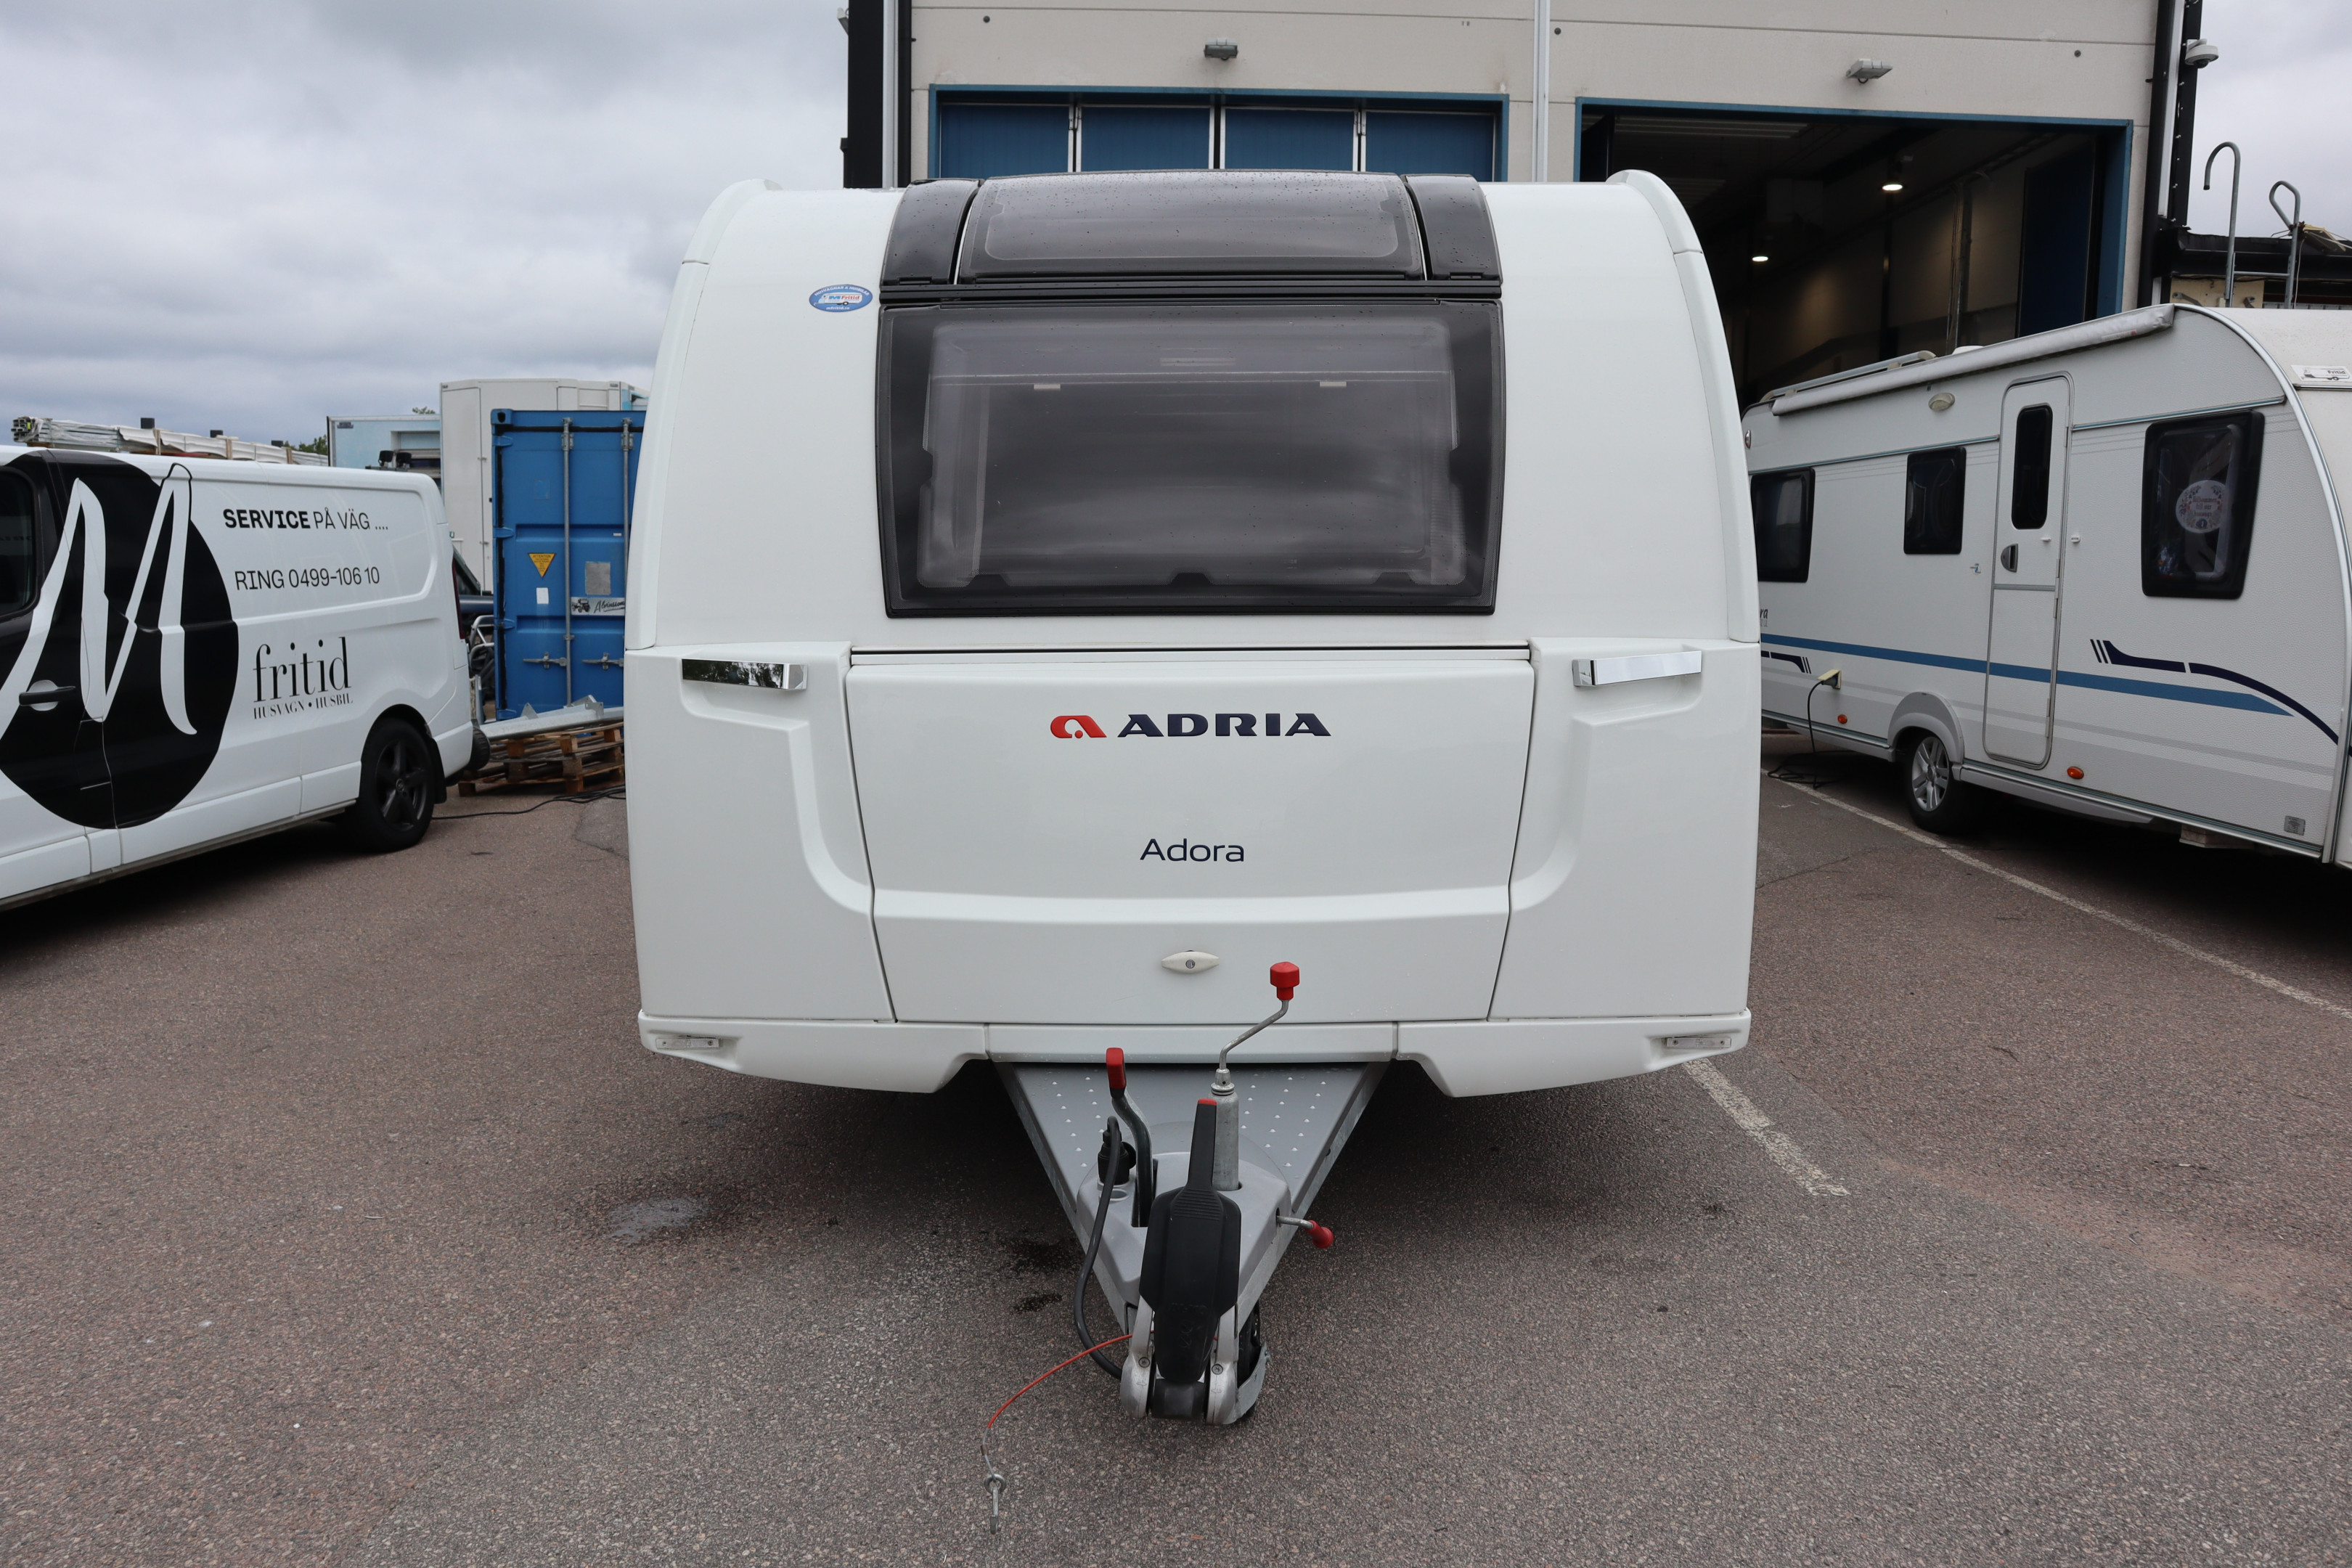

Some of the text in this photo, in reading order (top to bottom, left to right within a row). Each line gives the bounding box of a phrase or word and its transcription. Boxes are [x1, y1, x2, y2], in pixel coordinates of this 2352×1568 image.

[223, 508, 311, 529] SERVICE
[314, 507, 336, 529] PÅ
[337, 508, 371, 530] VÄG
[234, 566, 380, 591] RING 0499-106 10
[253, 636, 352, 703] fritid
[253, 693, 354, 719] HUSVAGN HUSBIL
[1116, 713, 1332, 738] ADRIA
[1140, 838, 1244, 862] Adora
